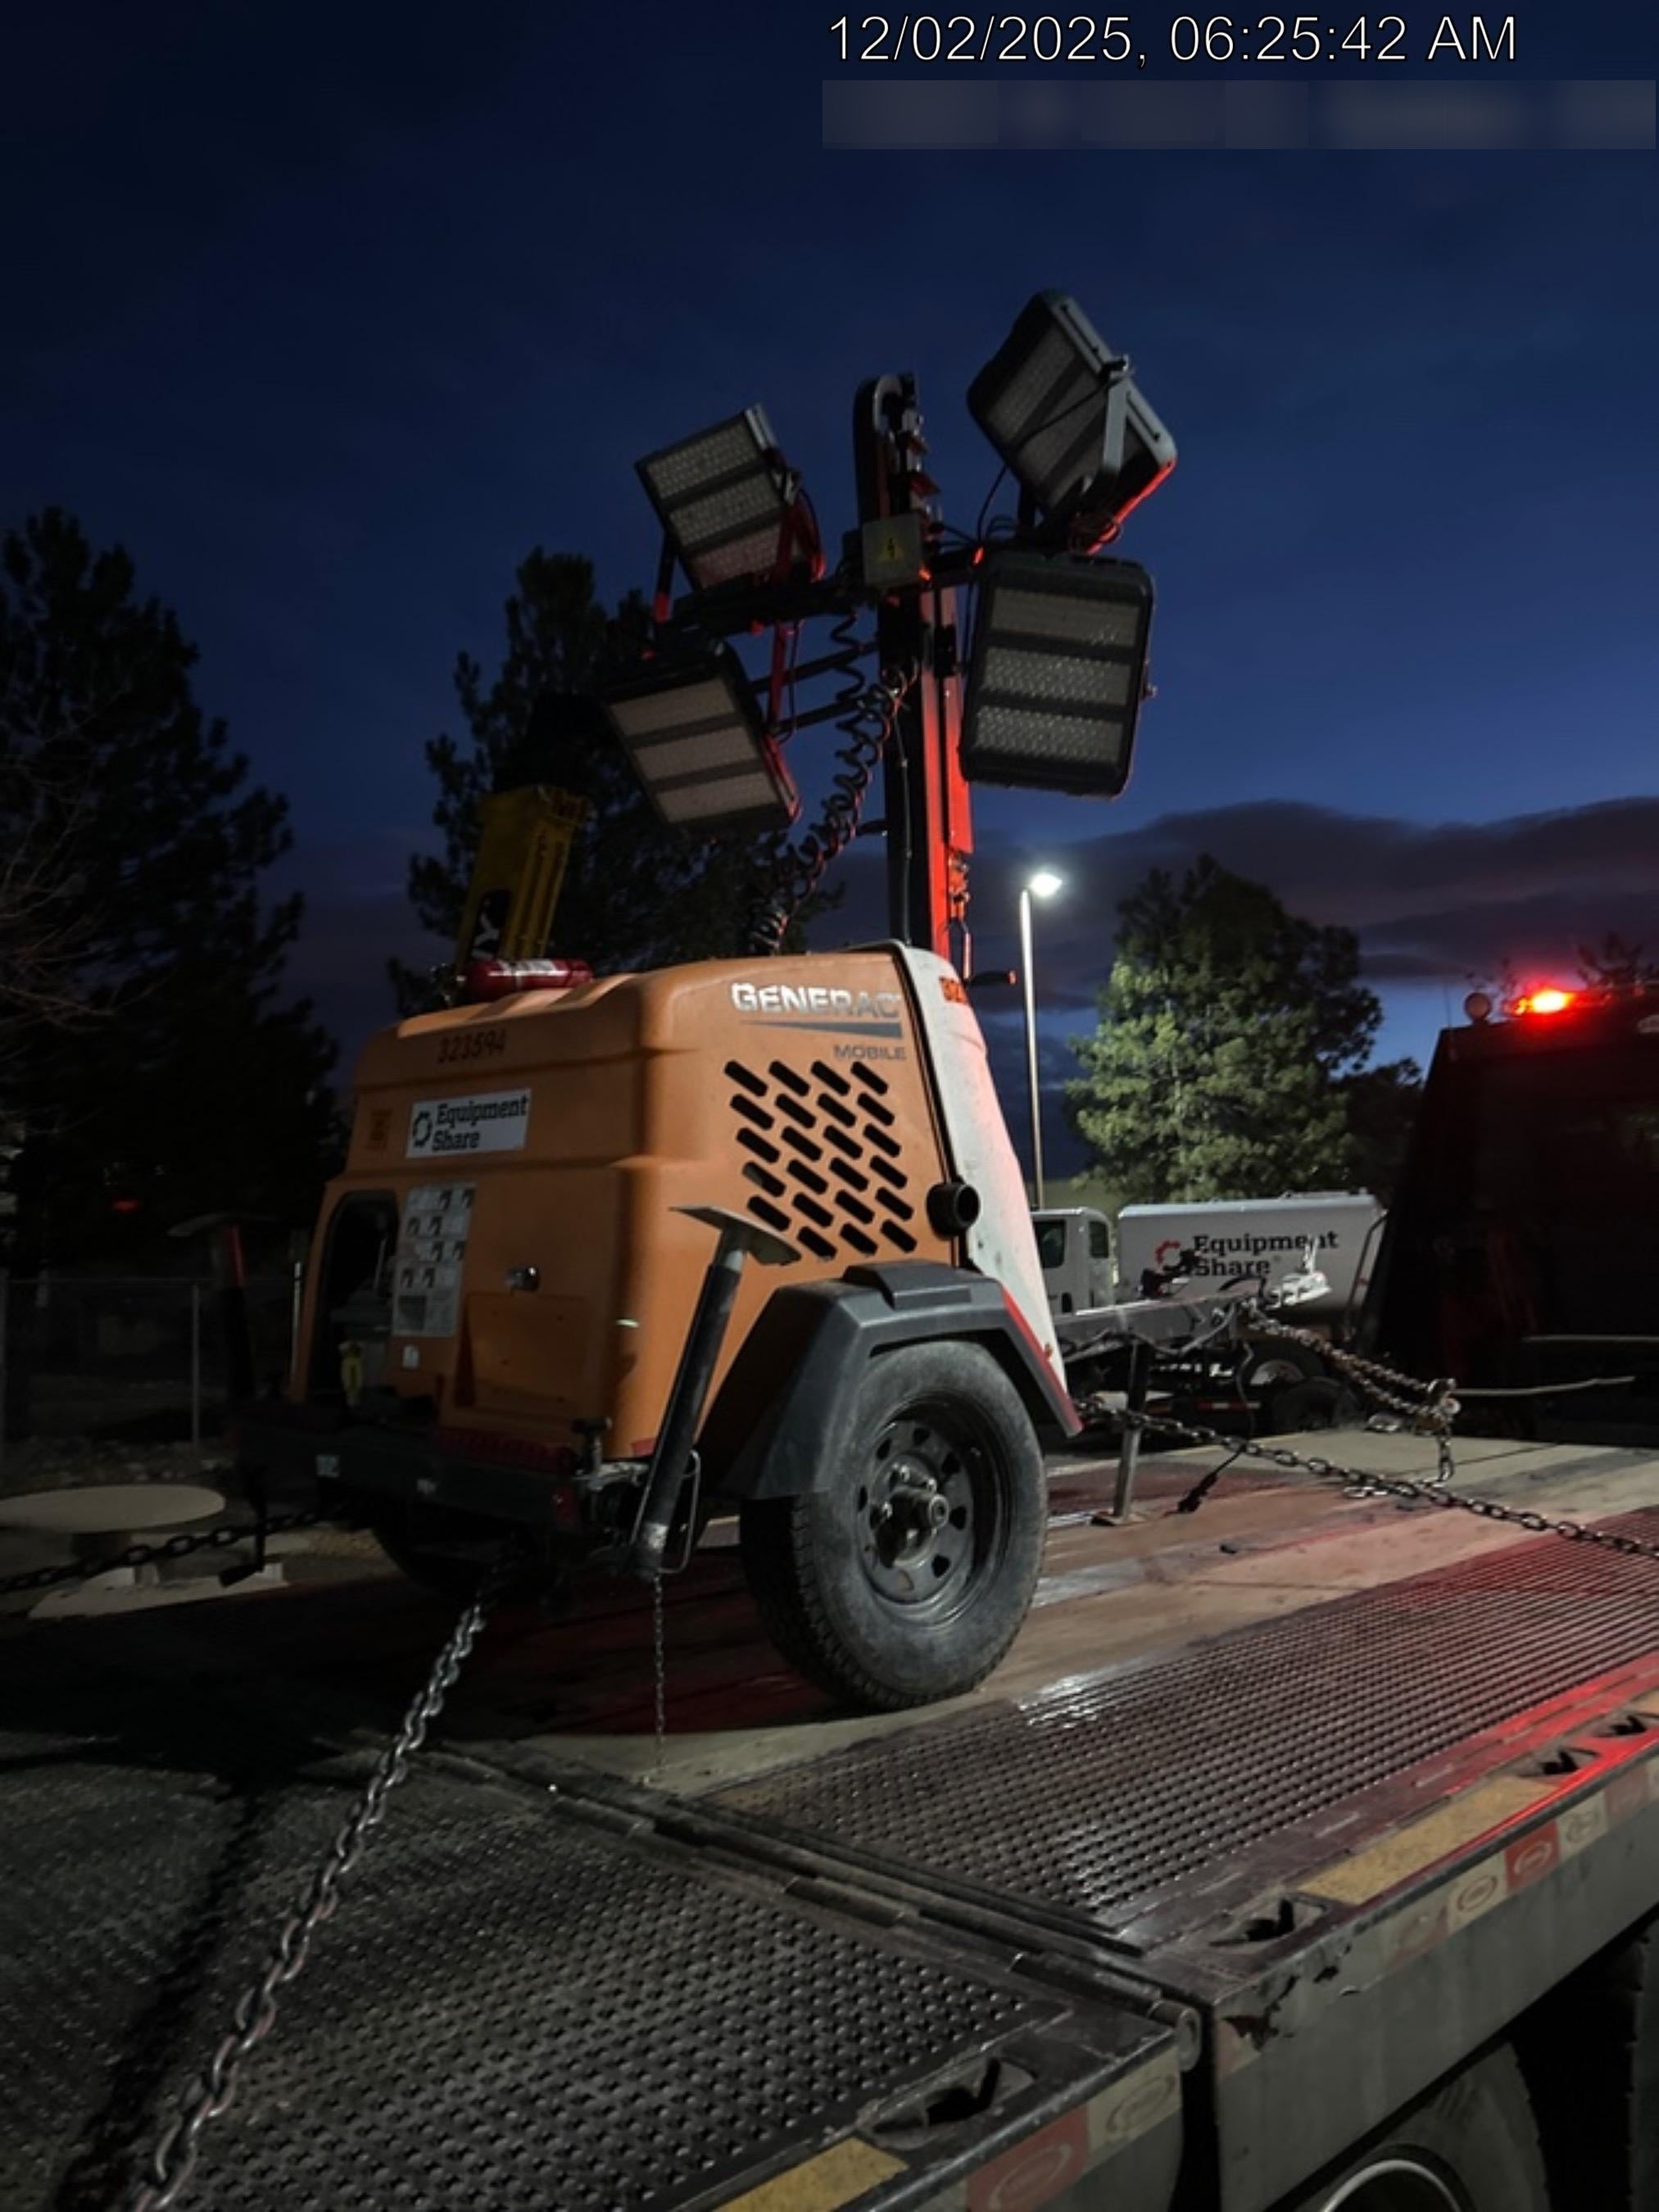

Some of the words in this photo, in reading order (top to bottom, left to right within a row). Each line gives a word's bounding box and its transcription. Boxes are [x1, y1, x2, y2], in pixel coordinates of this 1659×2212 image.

[730, 983, 903, 1018] GENERAC
[833, 1045, 905, 1060] MOBILE
[437, 1095, 527, 1129] Equipment
[432, 1130, 480, 1151] Share
[1194, 1258, 1271, 1276] Share
